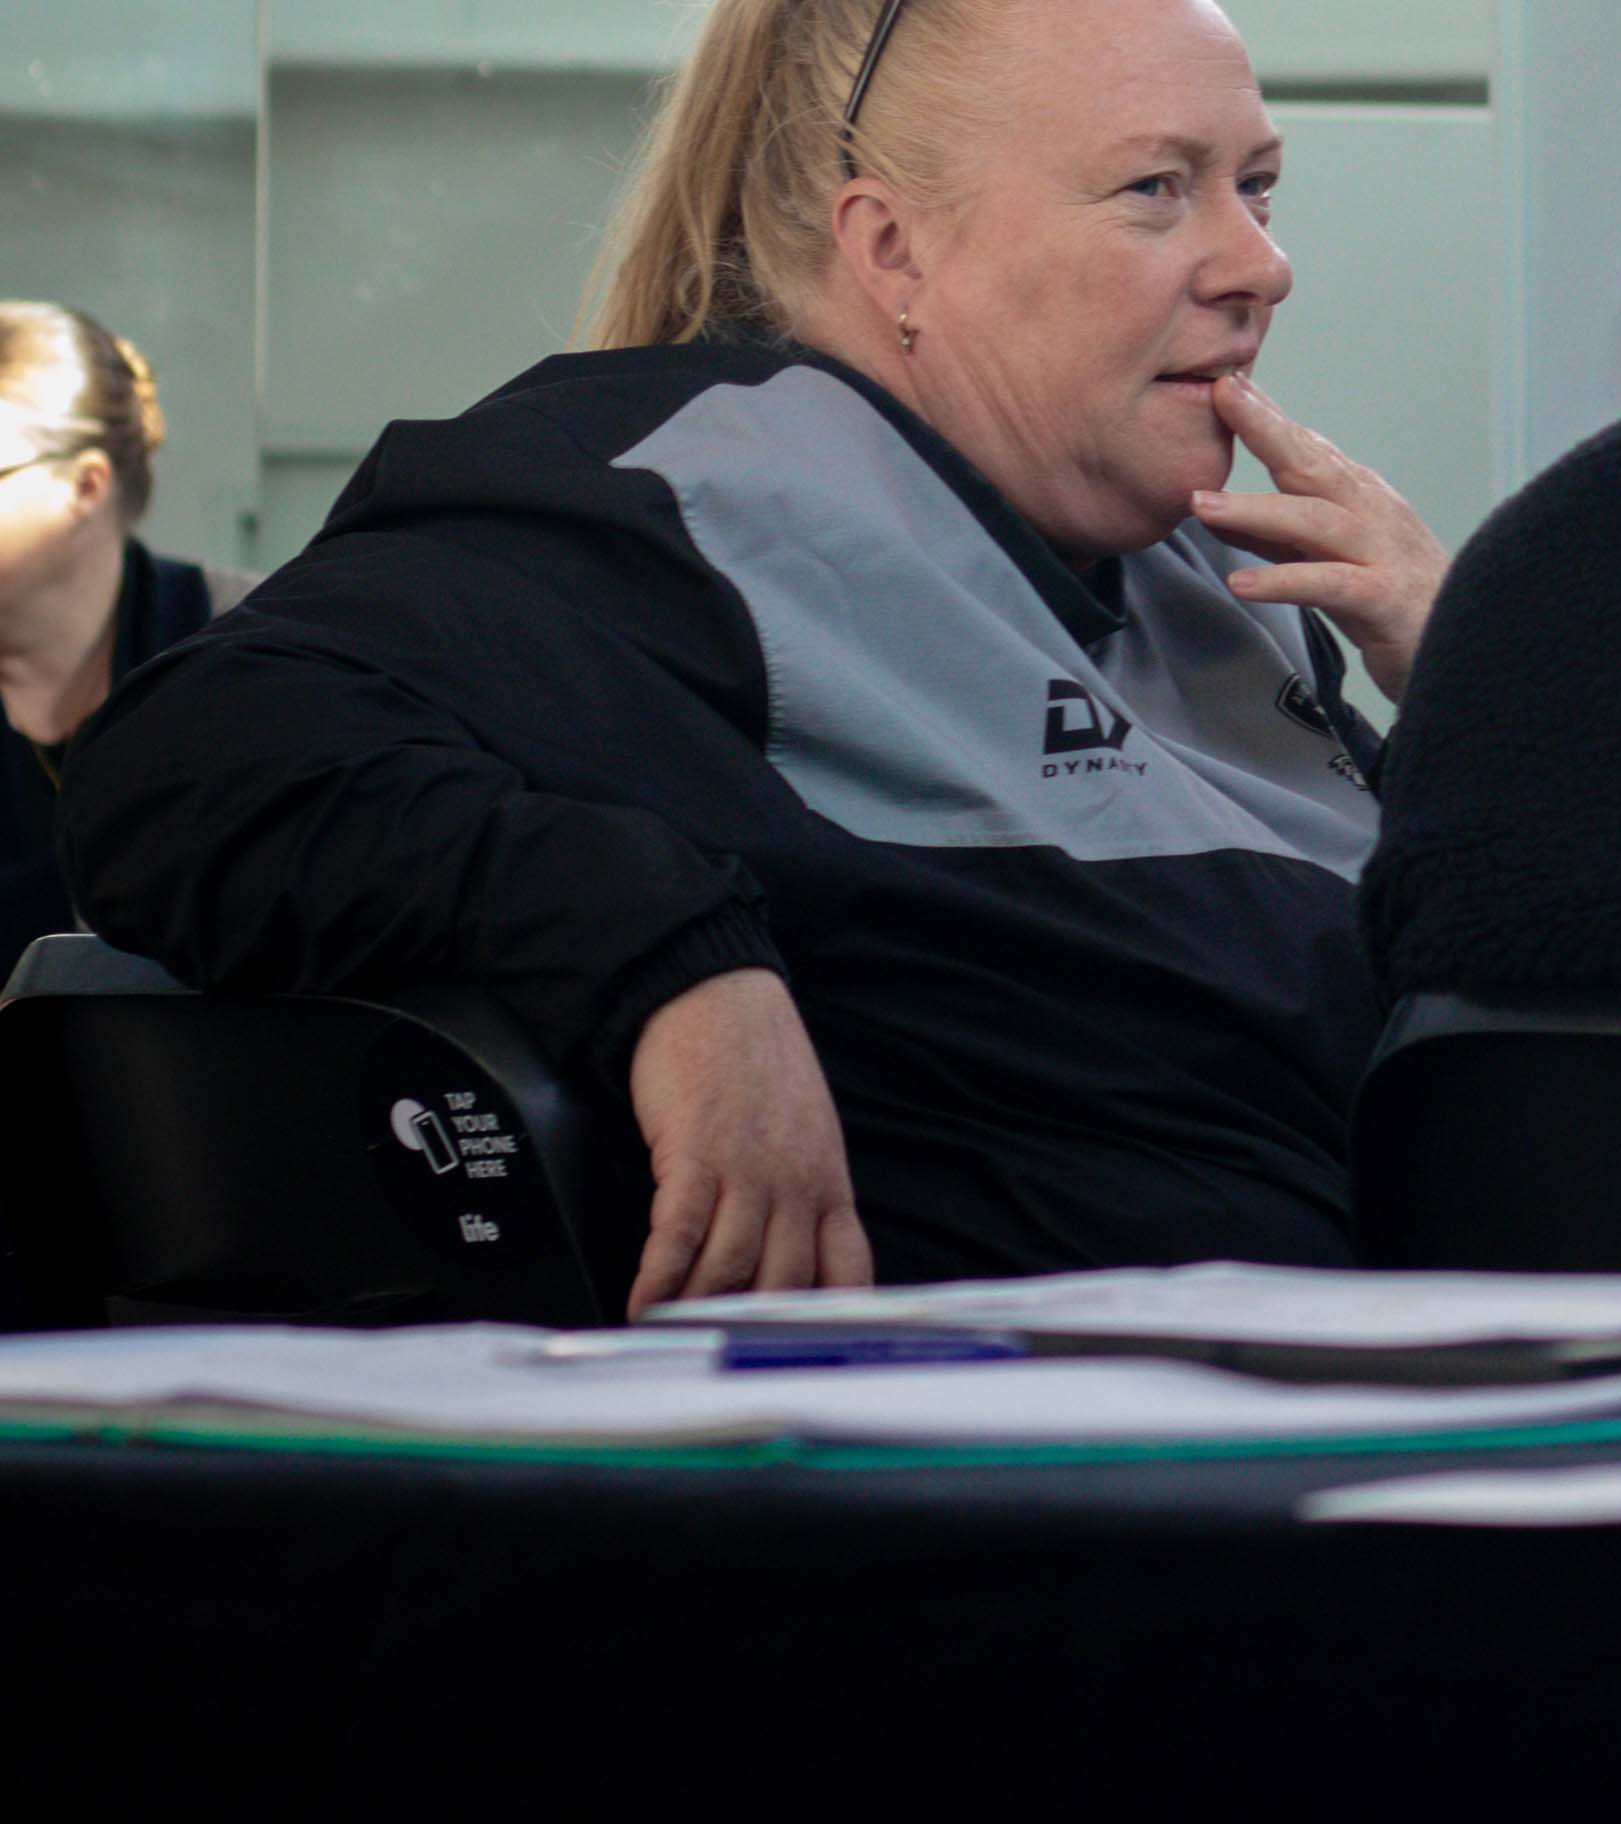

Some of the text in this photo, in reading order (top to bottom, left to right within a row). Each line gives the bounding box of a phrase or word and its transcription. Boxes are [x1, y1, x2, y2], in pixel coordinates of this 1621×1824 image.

[443, 1091, 477, 1110] TAP
[449, 1112, 500, 1133] YOUR
[457, 1133, 519, 1156] PHONE
[464, 1158, 508, 1179] HERE
[459, 1213, 501, 1243] life
